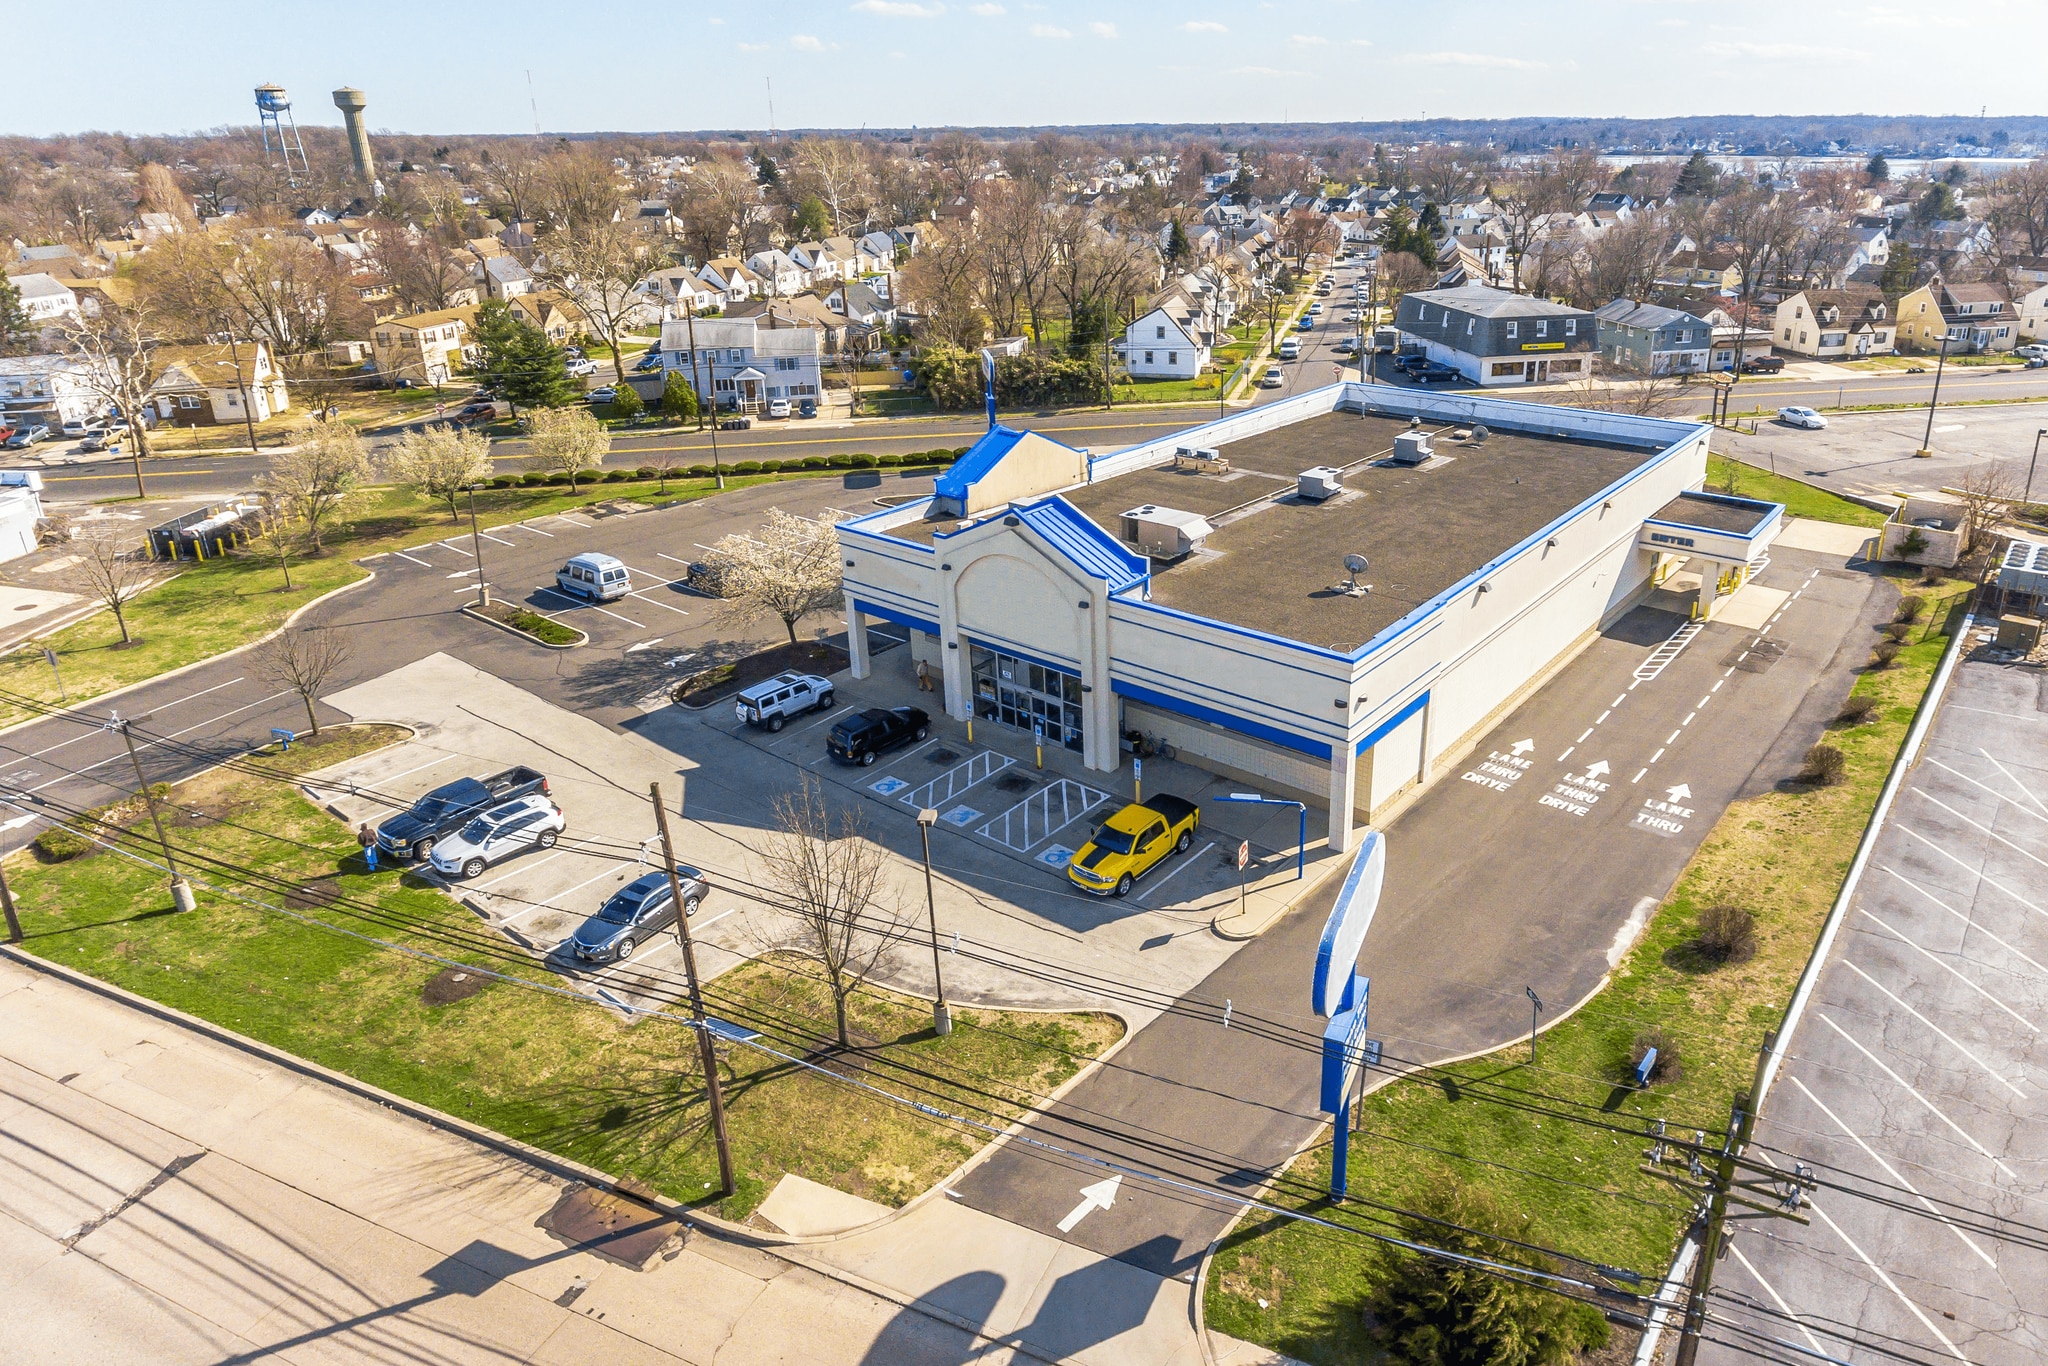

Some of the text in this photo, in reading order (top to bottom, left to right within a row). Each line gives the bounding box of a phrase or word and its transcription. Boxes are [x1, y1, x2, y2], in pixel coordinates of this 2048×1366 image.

[1651, 532, 1694, 547] ENTER
[1488, 750, 1534, 769] LANE
[1480, 761, 1523, 780] THRU
[1460, 771, 1511, 792] DRIVE
[1563, 772, 1611, 792] LANE
[1556, 784, 1600, 804] THRU
[1538, 795, 1590, 816] DRIVE
[1644, 798, 1695, 818] LANE
[1637, 812, 1684, 833] THRU
